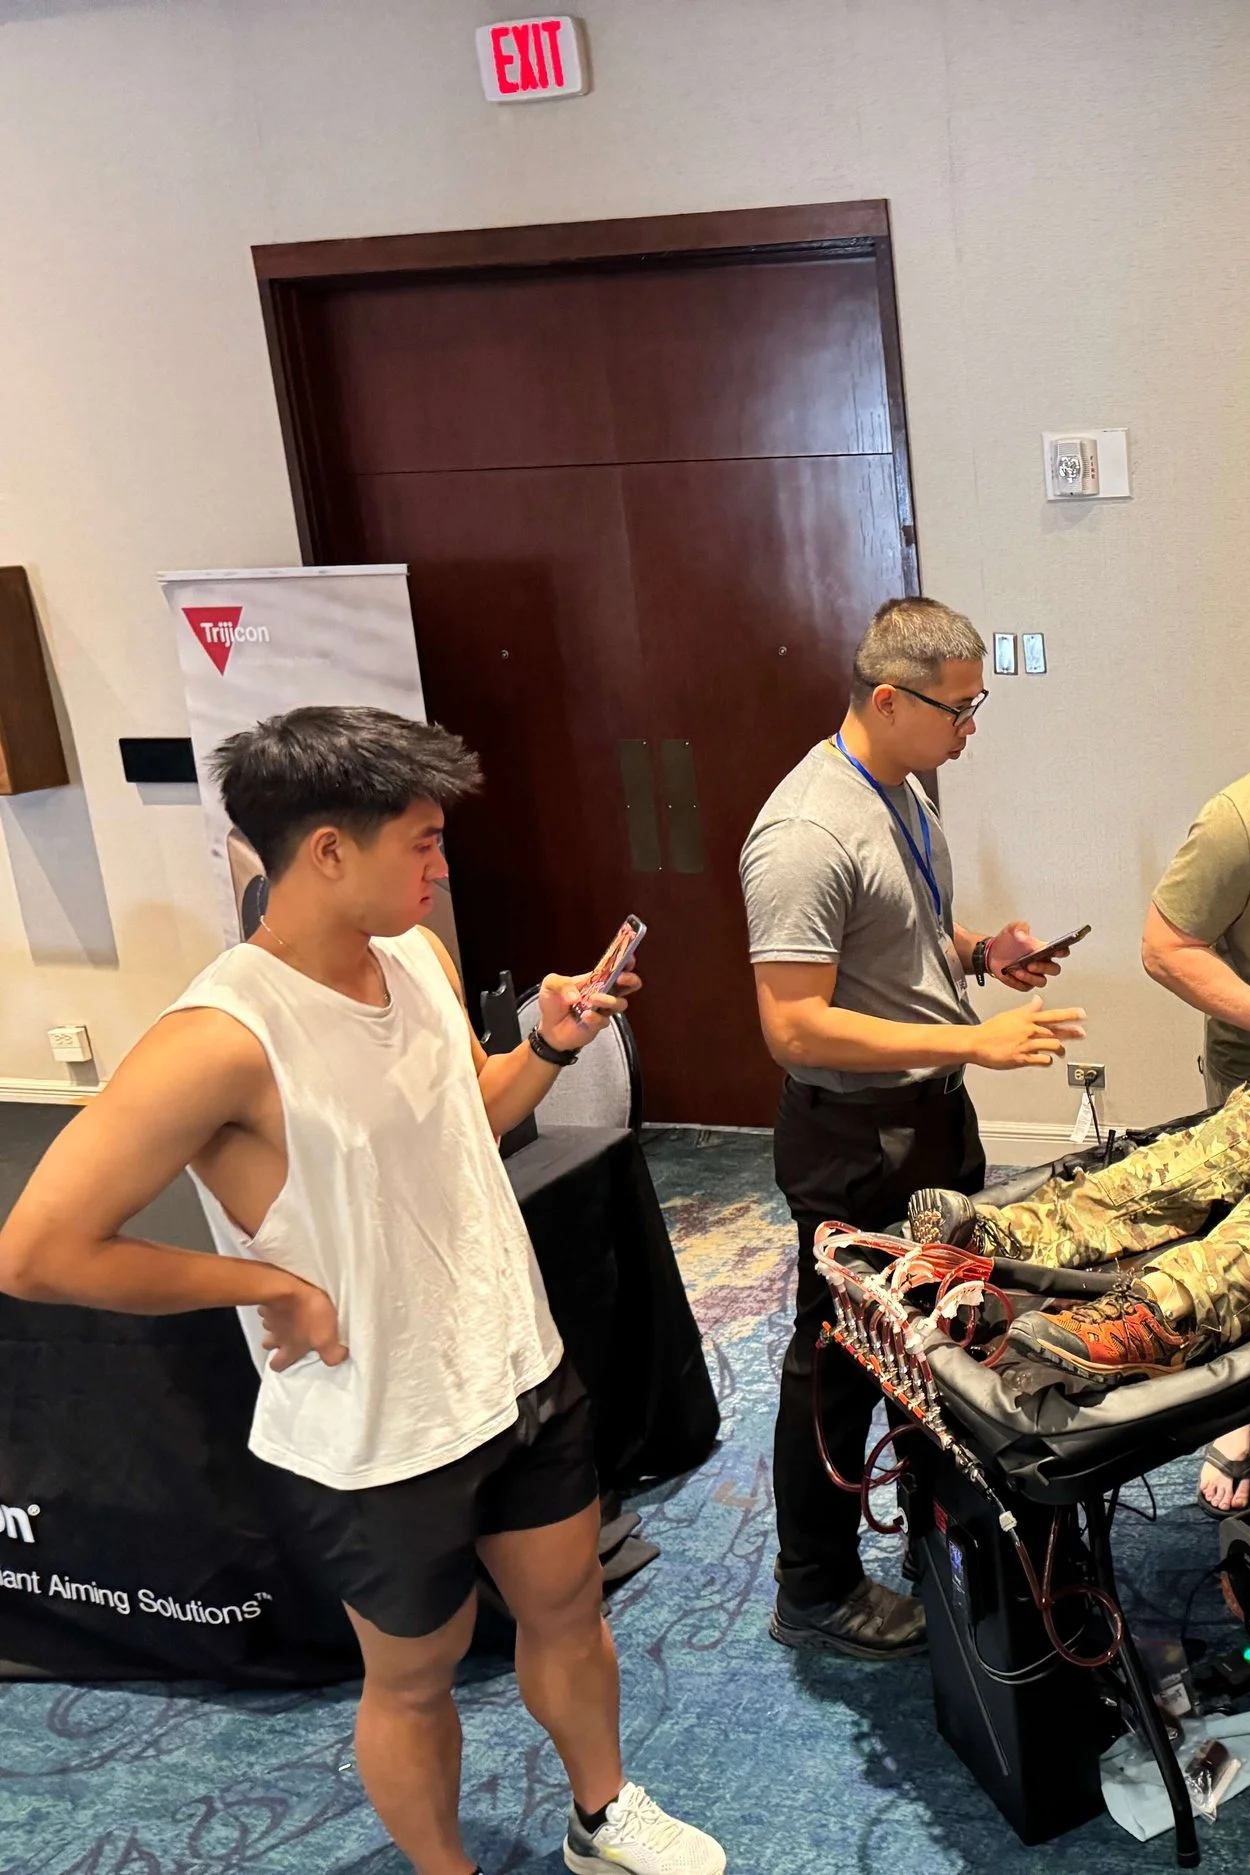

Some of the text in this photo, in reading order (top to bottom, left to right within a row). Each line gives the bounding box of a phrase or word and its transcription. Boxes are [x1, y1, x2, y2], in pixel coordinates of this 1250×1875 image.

[490, 20, 564, 94] EXIT
[200, 620, 270, 648] Trijicon
[48, 1574, 130, 1615] Aiming
